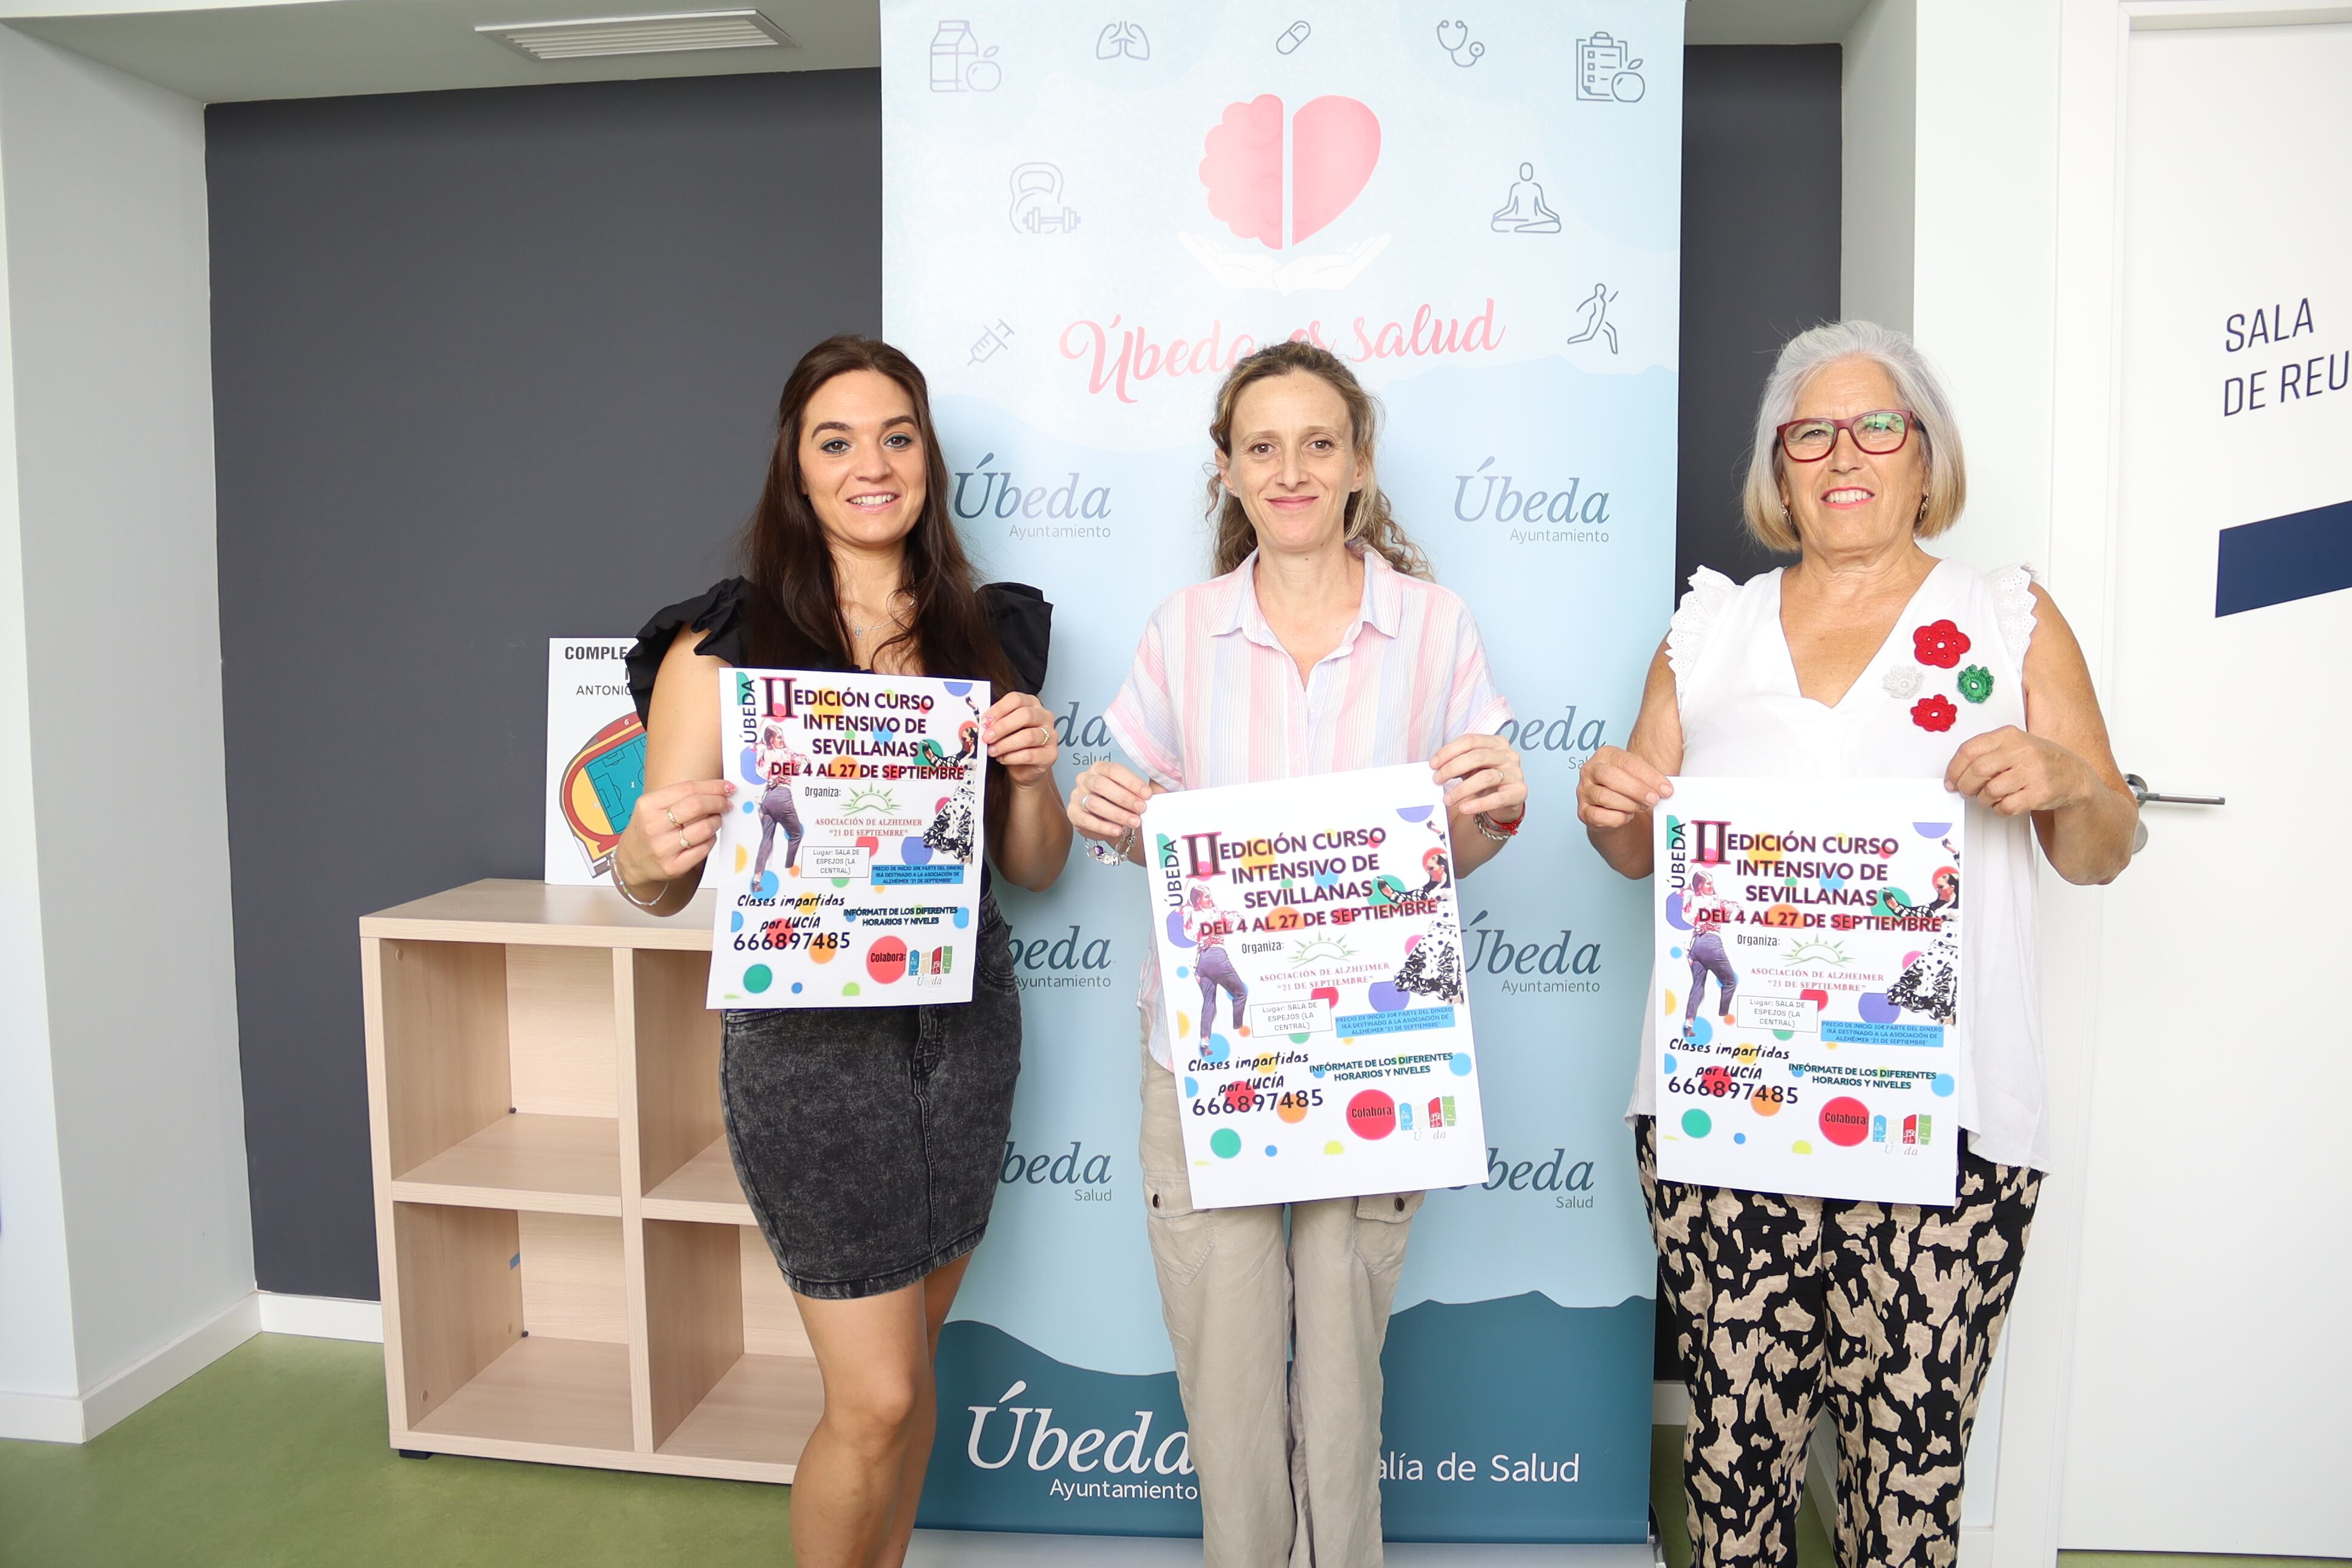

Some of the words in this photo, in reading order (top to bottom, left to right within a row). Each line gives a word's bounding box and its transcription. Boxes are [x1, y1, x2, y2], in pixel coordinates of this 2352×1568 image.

[2226, 298, 2314, 352] SALA
[1059, 314, 1254, 403] Úbeda
[1350, 297, 1506, 363] salud
[2224, 370, 2267, 417] DE
[2281, 350, 2350, 403] REU
[955, 452, 1111, 519] Úbeda
[1454, 456, 1610, 524] Úbeda
[1009, 524, 1111, 541] Ayuntamiento
[1510, 528, 1609, 544] Ayuntamiento
[760, 676, 798, 719] II
[794, 686, 869, 708] EDICIÓN
[874, 693, 934, 711] CURSO
[739, 679, 756, 742] ÚBEDA
[803, 714, 901, 733] INTENSIVO
[905, 719, 927, 734] DE
[812, 739, 918, 757] SEVILLANAS
[771, 762, 799, 776] DEL
[802, 762, 812, 776] 4
[815, 763, 835, 777] AL
[838, 764, 855, 777] 27
[860, 765, 878, 777] DE
[881, 765, 965, 780] SEPTIEMBRE
[804, 786, 840, 797] Organiza:
[1180, 831, 1226, 878] II
[1218, 830, 1307, 860] EDICIÓN
[1312, 826, 1387, 851] CURSO
[1691, 820, 1732, 864] II
[1728, 829, 1815, 852] EDICIÓN
[1823, 837, 1899, 855] CURSO
[1667, 823, 1686, 888] ÚBEDA
[1163, 840, 1183, 907] ÚBEDA
[1231, 855, 1347, 885] INTENSIVO
[1351, 853, 1379, 872] DE
[1737, 859, 1854, 879] INTENSIVO
[1860, 864, 1887, 880] DE
[737, 893, 776, 909] Clases
[780, 893, 844, 910] impartidas
[1243, 878, 1373, 910] SEVILLANAS
[1746, 885, 1877, 906] SEVILLANAS
[843, 906, 887, 916] INFÓRMATE
[916, 906, 958, 915] DIFERENTES
[1200, 920, 1233, 936] DEL
[1235, 918, 1248, 933] 4
[1251, 915, 1275, 932] AL
[1278, 913, 1299, 929] 27
[1303, 911, 1326, 926] DE
[1330, 898, 1438, 924] SEPTIEMBRE
[1699, 909, 1730, 923] DEL
[1734, 910, 1746, 924] 4
[1750, 910, 1773, 925] AL
[1778, 912, 1797, 926] 27
[1803, 914, 1826, 927] DE
[1831, 914, 1942, 932] SEPTIEMBRE
[761, 920, 782, 932] por
[786, 912, 820, 929] LUCÍA
[733, 932, 850, 951] 666897485
[1241, 939, 1284, 955] Organiza:
[1737, 934, 1779, 947] Organiza:
[1259, 969, 1316, 982] ASOCIACIÓN
[1334, 962, 1390, 975] ALZHEIMER
[1751, 967, 1808, 977] ASOCIACIÓN
[1828, 972, 1884, 981] ALZHEIMER
[1015, 975, 1111, 991] Ayuntamiento
[1501, 979, 1601, 996] Ayuntamiento
[1263, 1005, 1286, 1014] Lugar:
[1750, 999, 1773, 1008] Lugar:
[1267, 1013, 1299, 1022] ESPEJOS
[1187, 1056, 1230, 1073] Clases
[1235, 1049, 1309, 1071] impartidas
[1670, 1039, 1710, 1054] Clases
[1716, 1043, 1789, 1062] impartidas
[1309, 1059, 1363, 1073] INFÓRMATE
[1379, 1057, 1396, 1066] LOS
[1399, 1052, 1453, 1065] DIFERENTES
[1334, 1069, 1383, 1081] HORARIOS
[1393, 1065, 1430, 1076] NIVELES
[1696, 1067, 1718, 1079] por
[1723, 1062, 1762, 1079] LUCÍA
[1789, 1062, 1843, 1074] INFÓRMATE
[1880, 1070, 1936, 1080] DIFERENTES
[1217, 1082, 1241, 1096] por
[1244, 1071, 1284, 1091] LUCÍA
[1668, 1077, 1798, 1103] 666897485
[1812, 1076, 1862, 1085] HORARIOS
[1873, 1080, 1911, 1089] NIVELES
[1192, 1088, 1324, 1116] 666897485
[1447, 1148, 1595, 1191] beda
[1074, 1188, 1112, 1201] Salud
[1556, 1195, 1593, 1209] Salud
[968, 1380, 1196, 1475] Úbeda
[1437, 1452, 1477, 1481] de
[1490, 1452, 1579, 1482] Salud
[1050, 1478, 1198, 1501] Ayuntamiento
